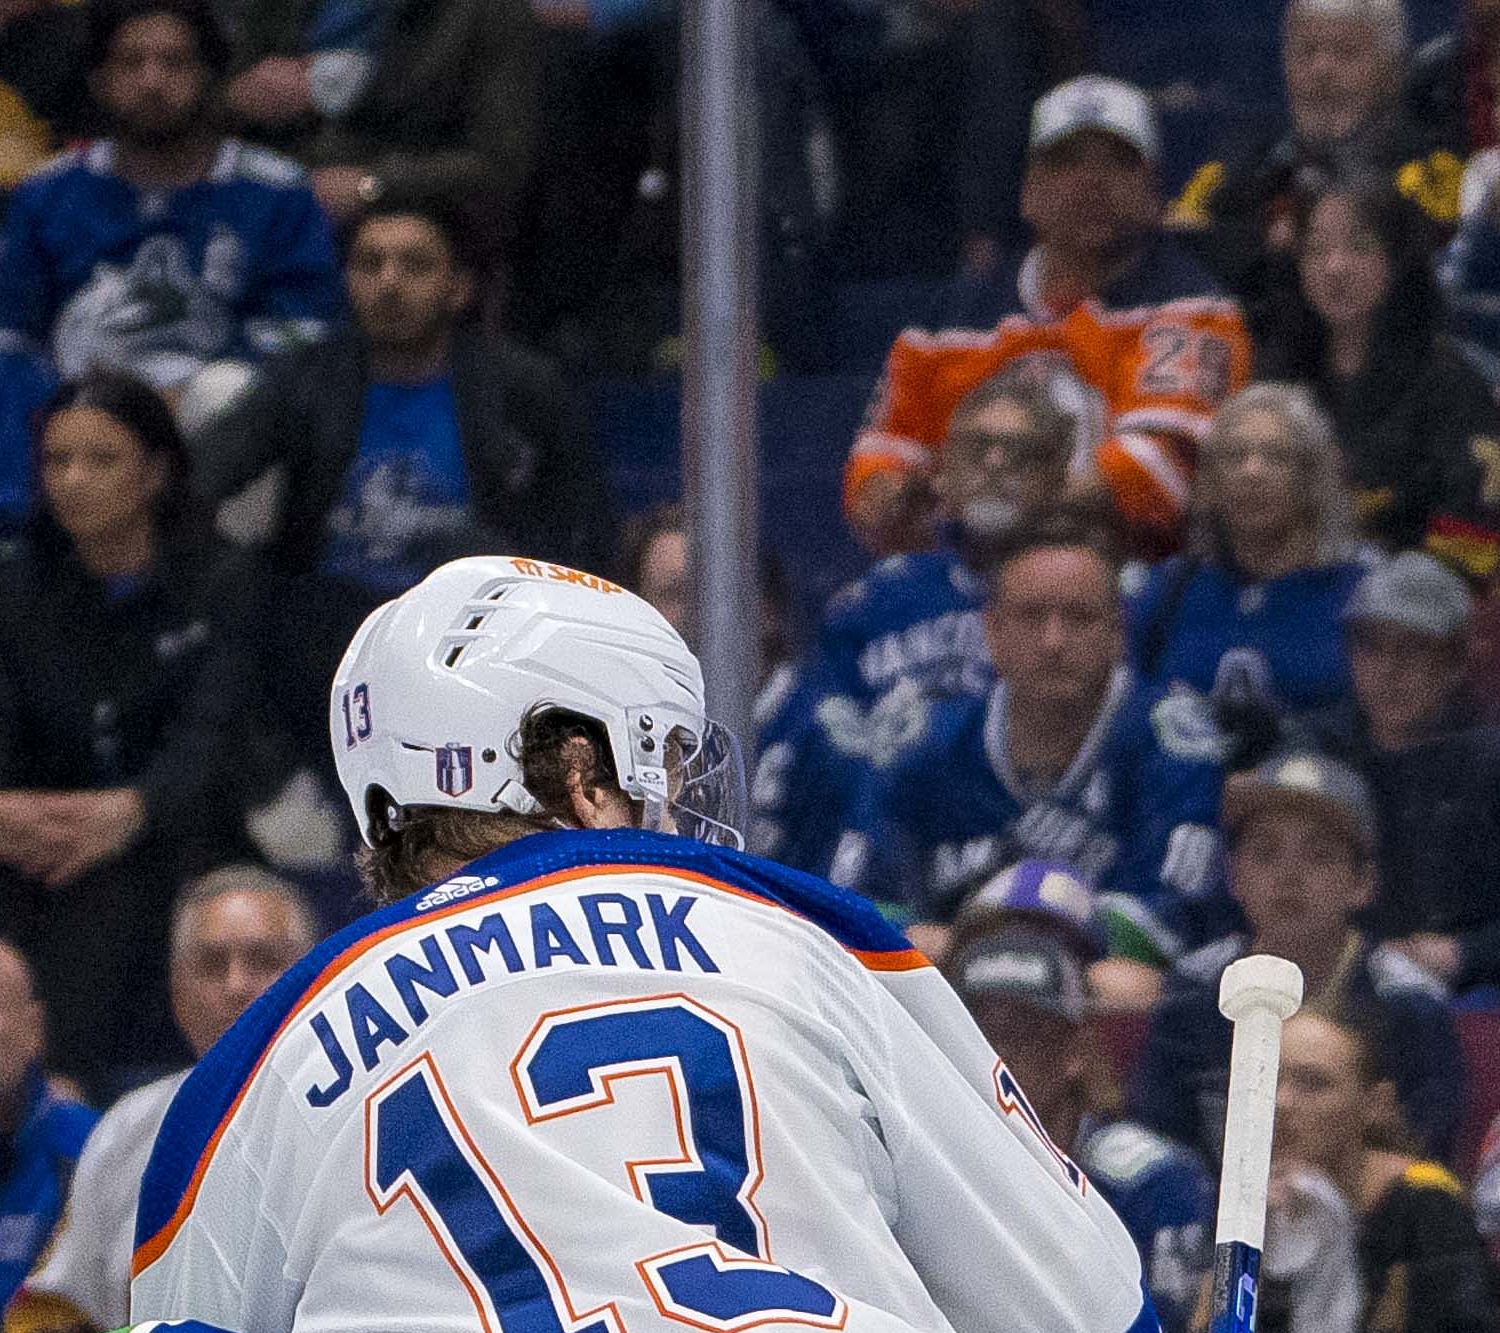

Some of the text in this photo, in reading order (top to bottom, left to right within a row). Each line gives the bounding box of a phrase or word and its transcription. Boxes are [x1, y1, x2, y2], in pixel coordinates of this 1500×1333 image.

[341, 681, 374, 752] 13
[415, 875, 499, 911] adidas
[305, 892, 722, 1109] JANMARK
